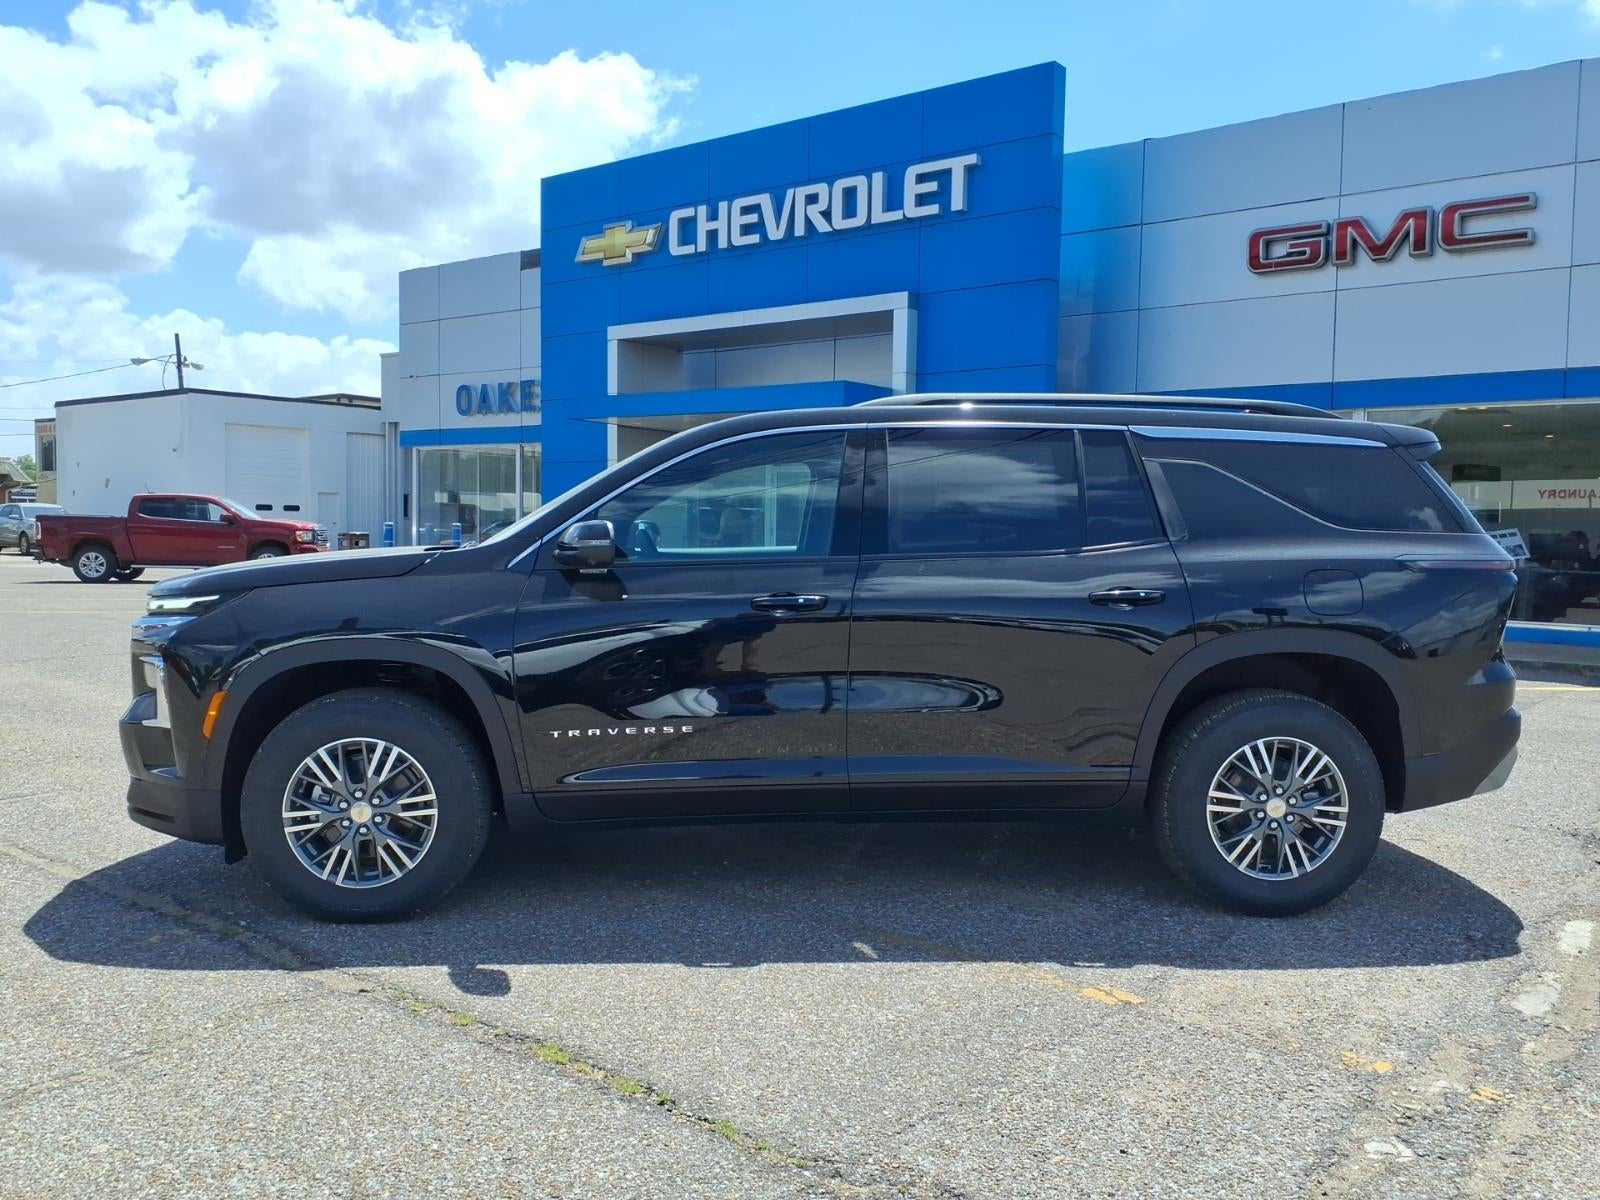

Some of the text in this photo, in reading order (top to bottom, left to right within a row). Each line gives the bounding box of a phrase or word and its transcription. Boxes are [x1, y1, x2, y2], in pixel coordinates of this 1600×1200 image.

[668, 153, 981, 256] CHEVROLET
[1247, 191, 1537, 274] GMC
[550, 725, 694, 738] TRAVERSE
